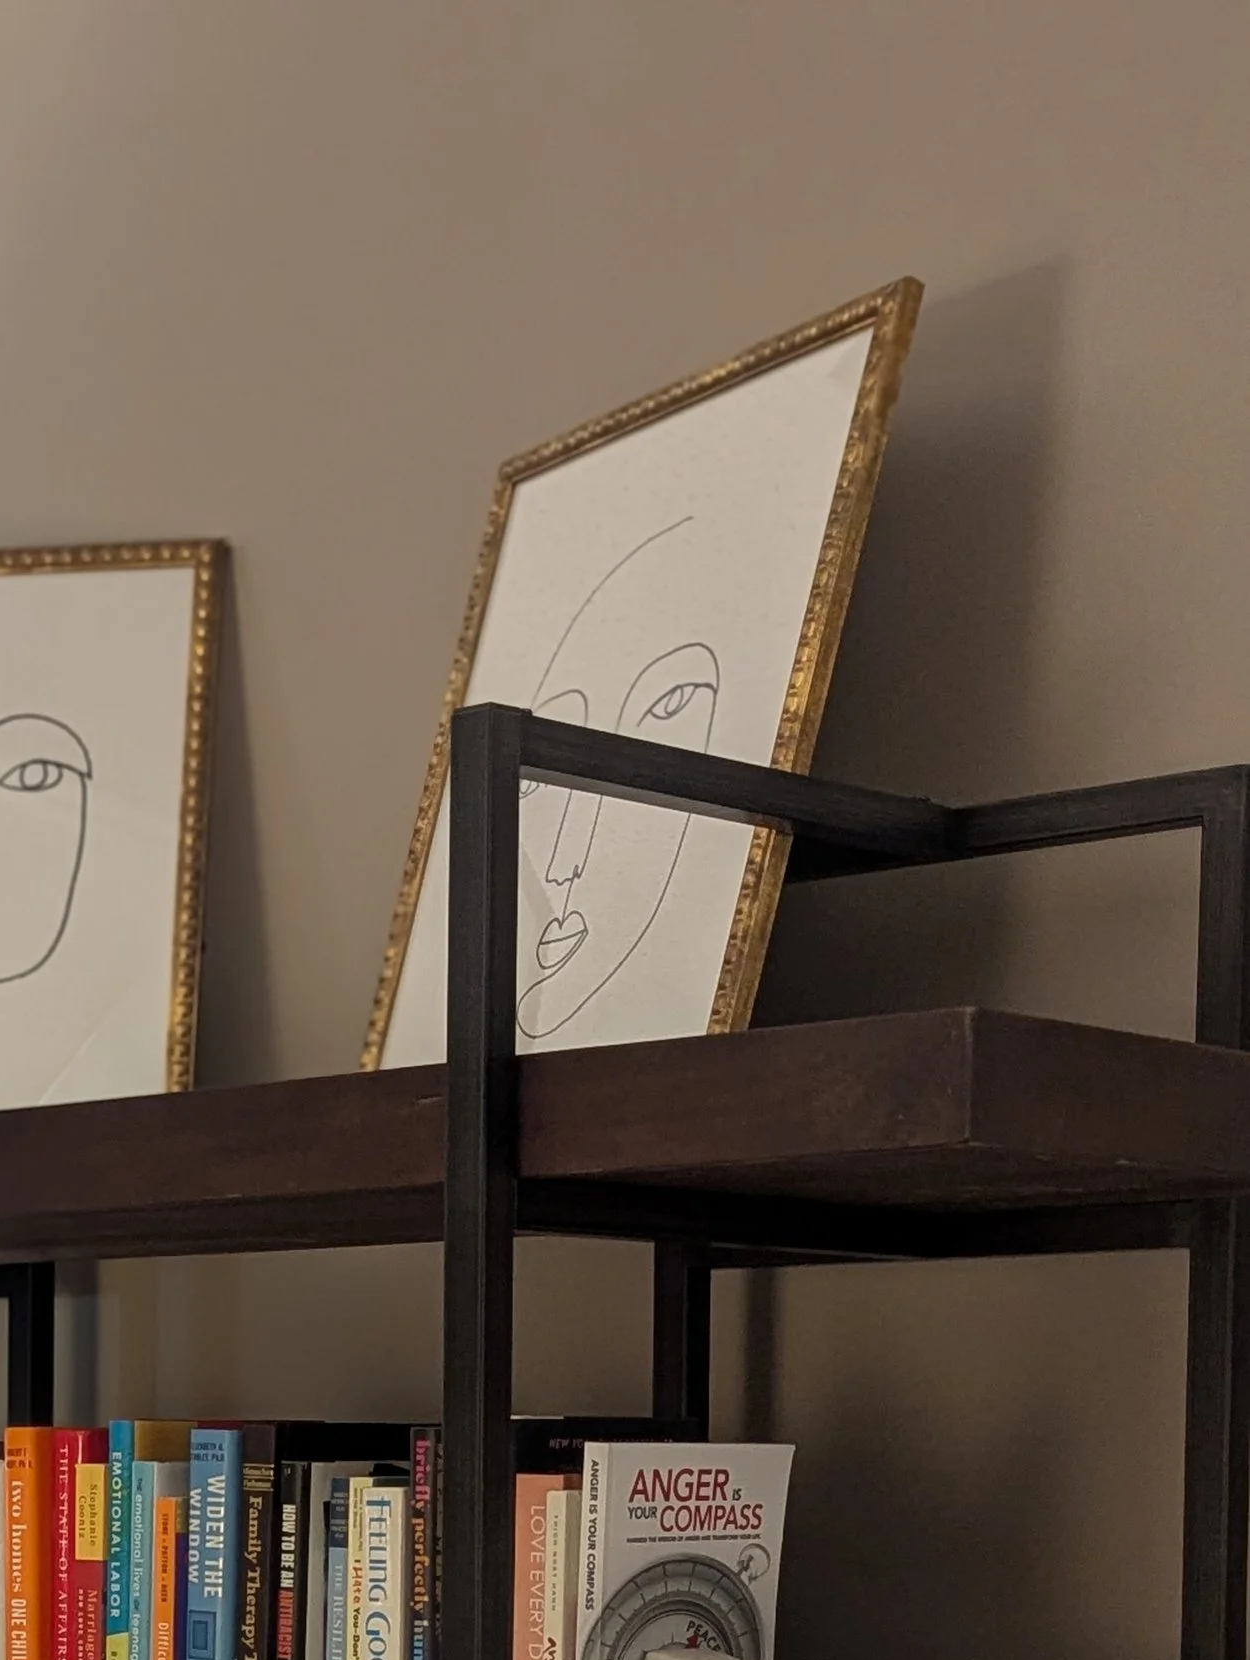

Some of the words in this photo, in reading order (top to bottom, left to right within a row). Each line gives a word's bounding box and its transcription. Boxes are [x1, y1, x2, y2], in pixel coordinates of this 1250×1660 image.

[11, 1480, 24, 1517] two
[588, 1459, 599, 1502] ANGER
[628, 1468, 730, 1503] ANGER
[732, 1489, 743, 1501] IS
[78, 1495, 87, 1538] Coontz
[89, 1484, 98, 1547] Stephanie
[110, 1452, 122, 1554] EMOTIONAL
[206, 1474, 226, 1549] WIDEN
[282, 1504, 296, 1533] HOW
[588, 1505, 598, 1516] IS
[627, 1506, 658, 1520] YOUR
[660, 1504, 763, 1532] COMPASS
[188, 1488, 202, 1585] WINDOW
[243, 1496, 263, 1563] Family
[282, 1535, 295, 1550] TO
[366, 1497, 391, 1602] FEELING
[530, 1505, 546, 1560] LOVE
[587, 1518, 598, 1550] YOUR
[12, 1523, 27, 1592] homes
[203, 1557, 223, 1599] THE
[281, 1570, 294, 1588] AN
[282, 1552, 295, 1569] BE
[109, 1561, 121, 1618] LABOR
[352, 1566, 362, 1604] Hate
[528, 1567, 546, 1636] EVERY
[585, 1552, 597, 1611] COMPASS
[11, 1599, 26, 1627] ONE
[240, 1565, 262, 1649] Therapy
[277, 1590, 294, 1660] ANTIRACIST
